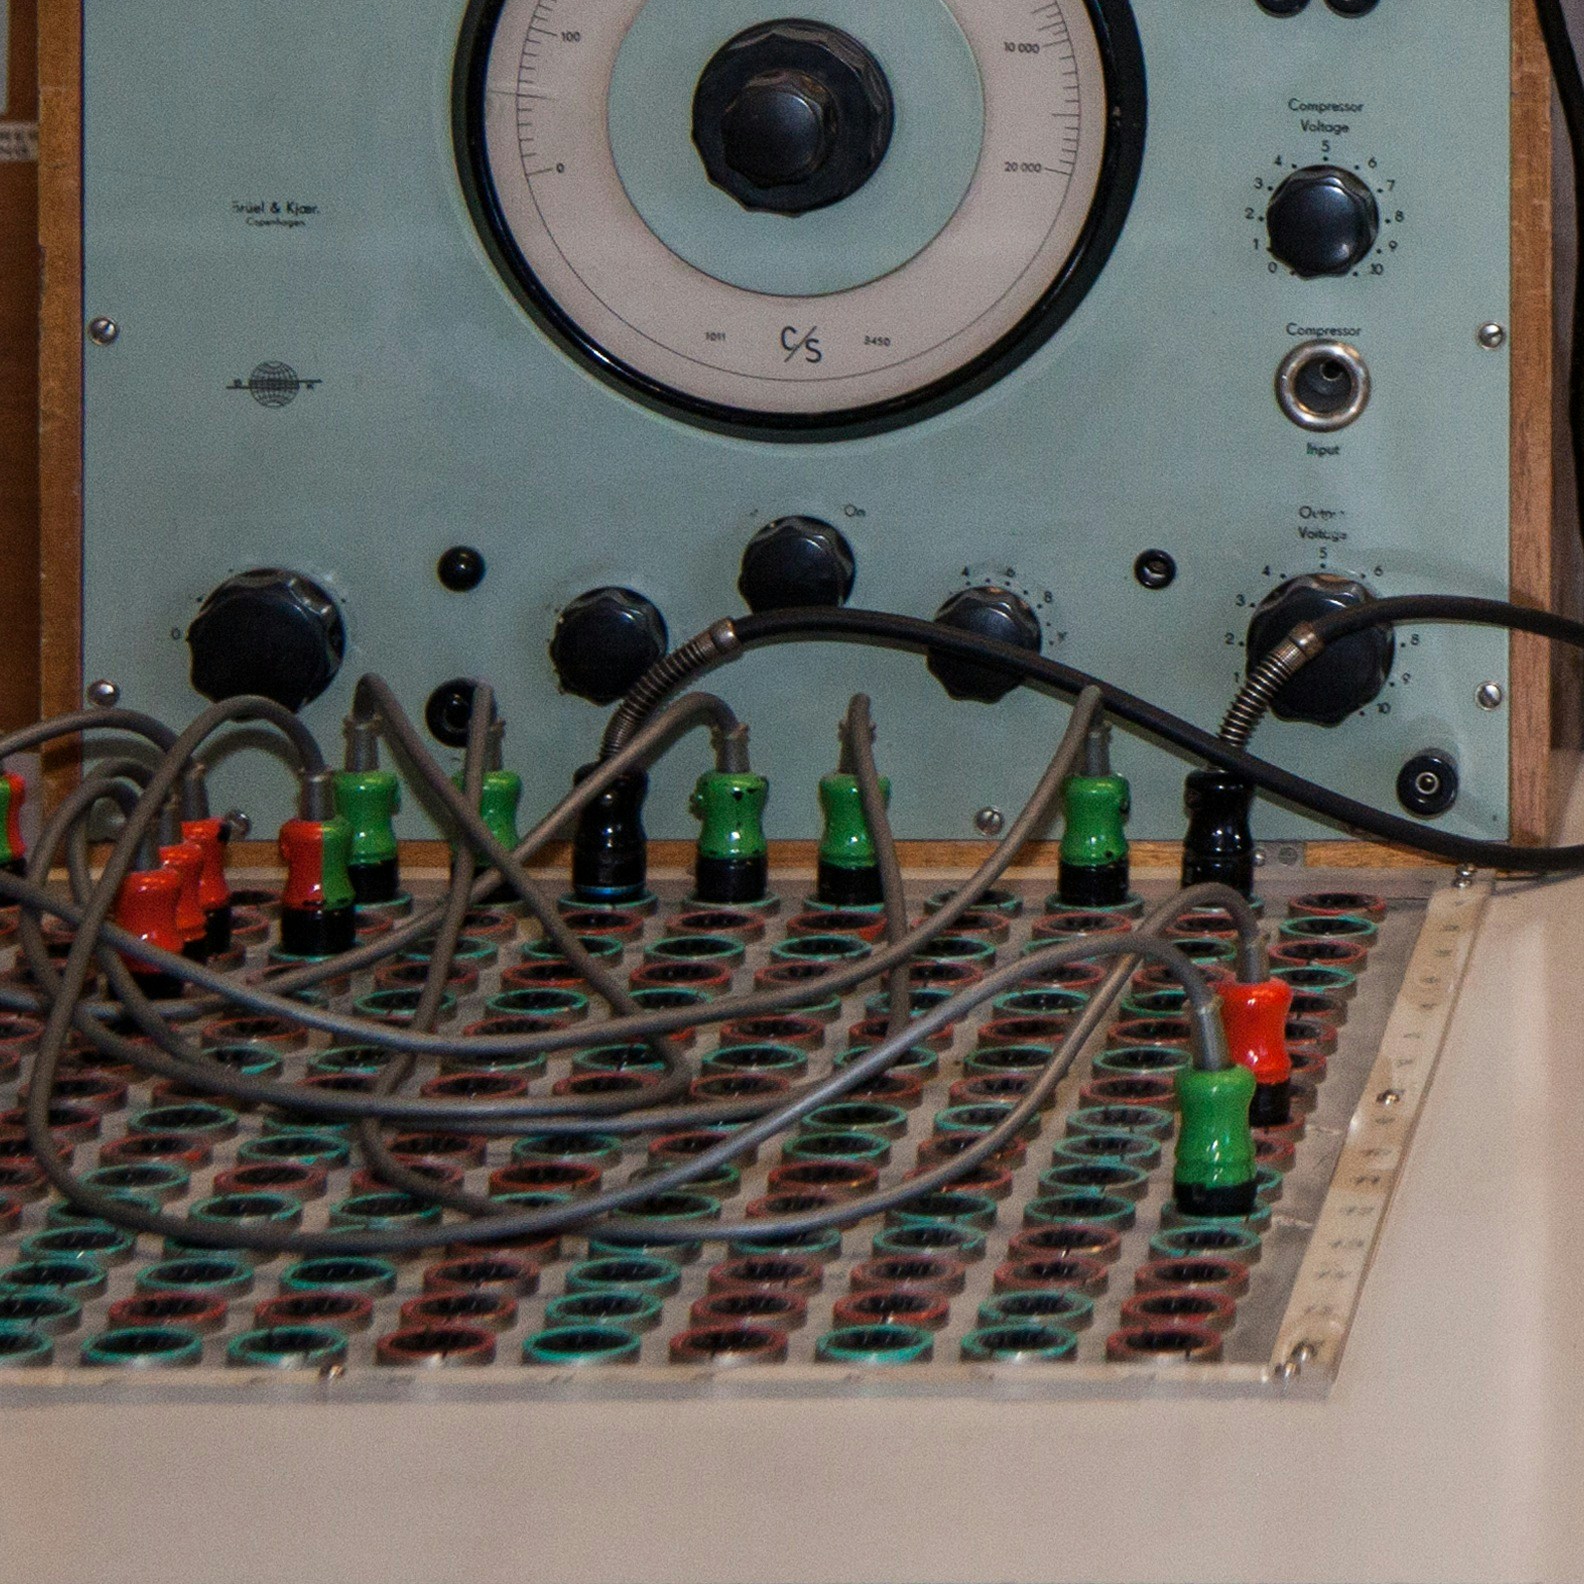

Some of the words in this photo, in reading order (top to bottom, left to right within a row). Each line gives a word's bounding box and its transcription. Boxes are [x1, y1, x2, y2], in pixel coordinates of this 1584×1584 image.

[560, 31, 581, 43] 100
[1288, 97, 1364, 115] Compressor
[1300, 119, 1350, 135] Voltage
[1321, 139, 1330, 153] 5
[555, 162, 565, 174] 0
[1274, 154, 1283, 166] 4
[1367, 156, 1378, 169] 6
[1254, 177, 1263, 190] 3
[1386, 179, 1396, 192] 7
[269, 201, 281, 214] &
[1244, 207, 1254, 220] 2
[1394, 209, 1405, 223] 8
[1252, 237, 1260, 250] 1
[1267, 261, 1278, 274] 0
[1285, 321, 1362, 338] Compressor
[1306, 441, 1340, 457] Input
[1319, 546, 1328, 559] 5
[1261, 565, 1271, 577] 4
[1373, 565, 1384, 577] 6
[1235, 593, 1246, 607] 3
[1224, 632, 1235, 646] 2
[1410, 633, 1420, 646] 8
